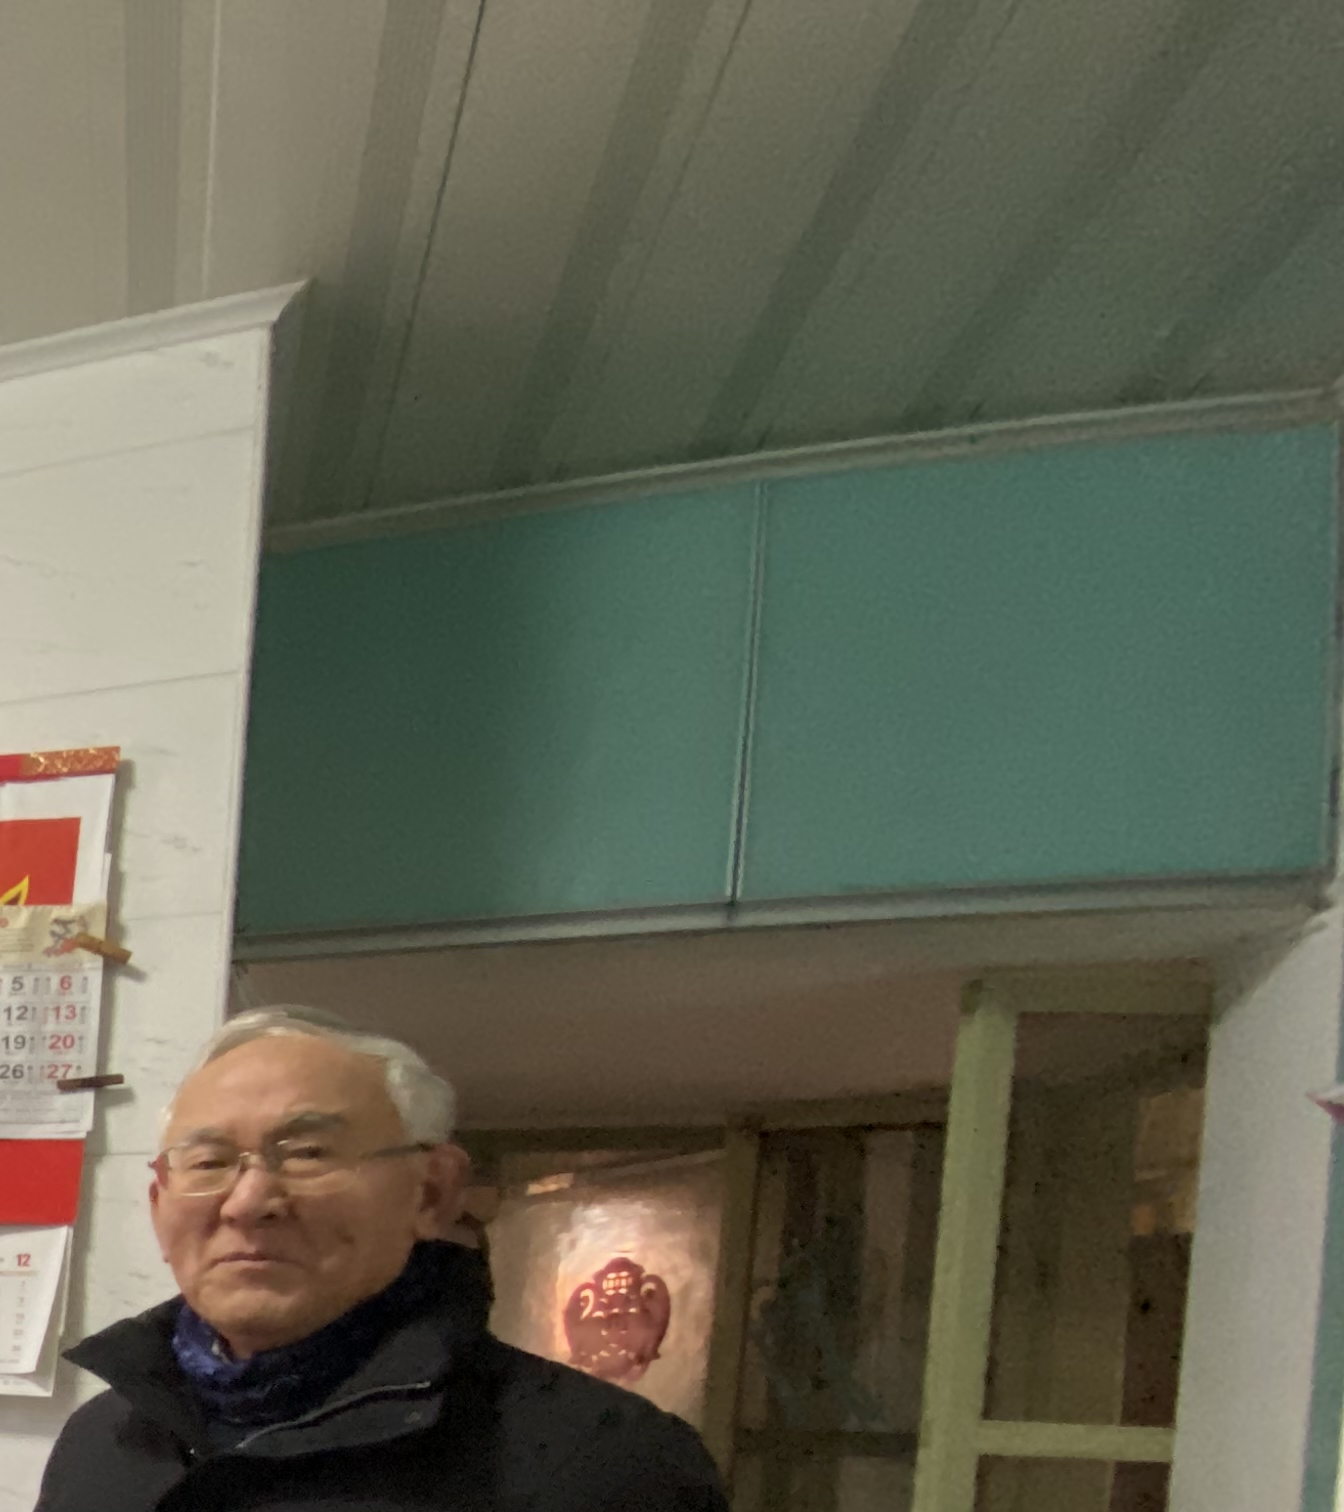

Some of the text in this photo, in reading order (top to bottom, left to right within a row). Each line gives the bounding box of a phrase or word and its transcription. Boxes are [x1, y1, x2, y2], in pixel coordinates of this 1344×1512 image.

[12, 976, 24, 991] 5
[59, 975, 72, 990] 6
[3, 1006, 28, 1021] 12
[52, 1005, 77, 1021] 13
[2, 1035, 26, 1050] 19
[48, 1034, 75, 1050] 20
[46, 1064, 73, 1079] 27
[16, 1253, 32, 1267] 12
